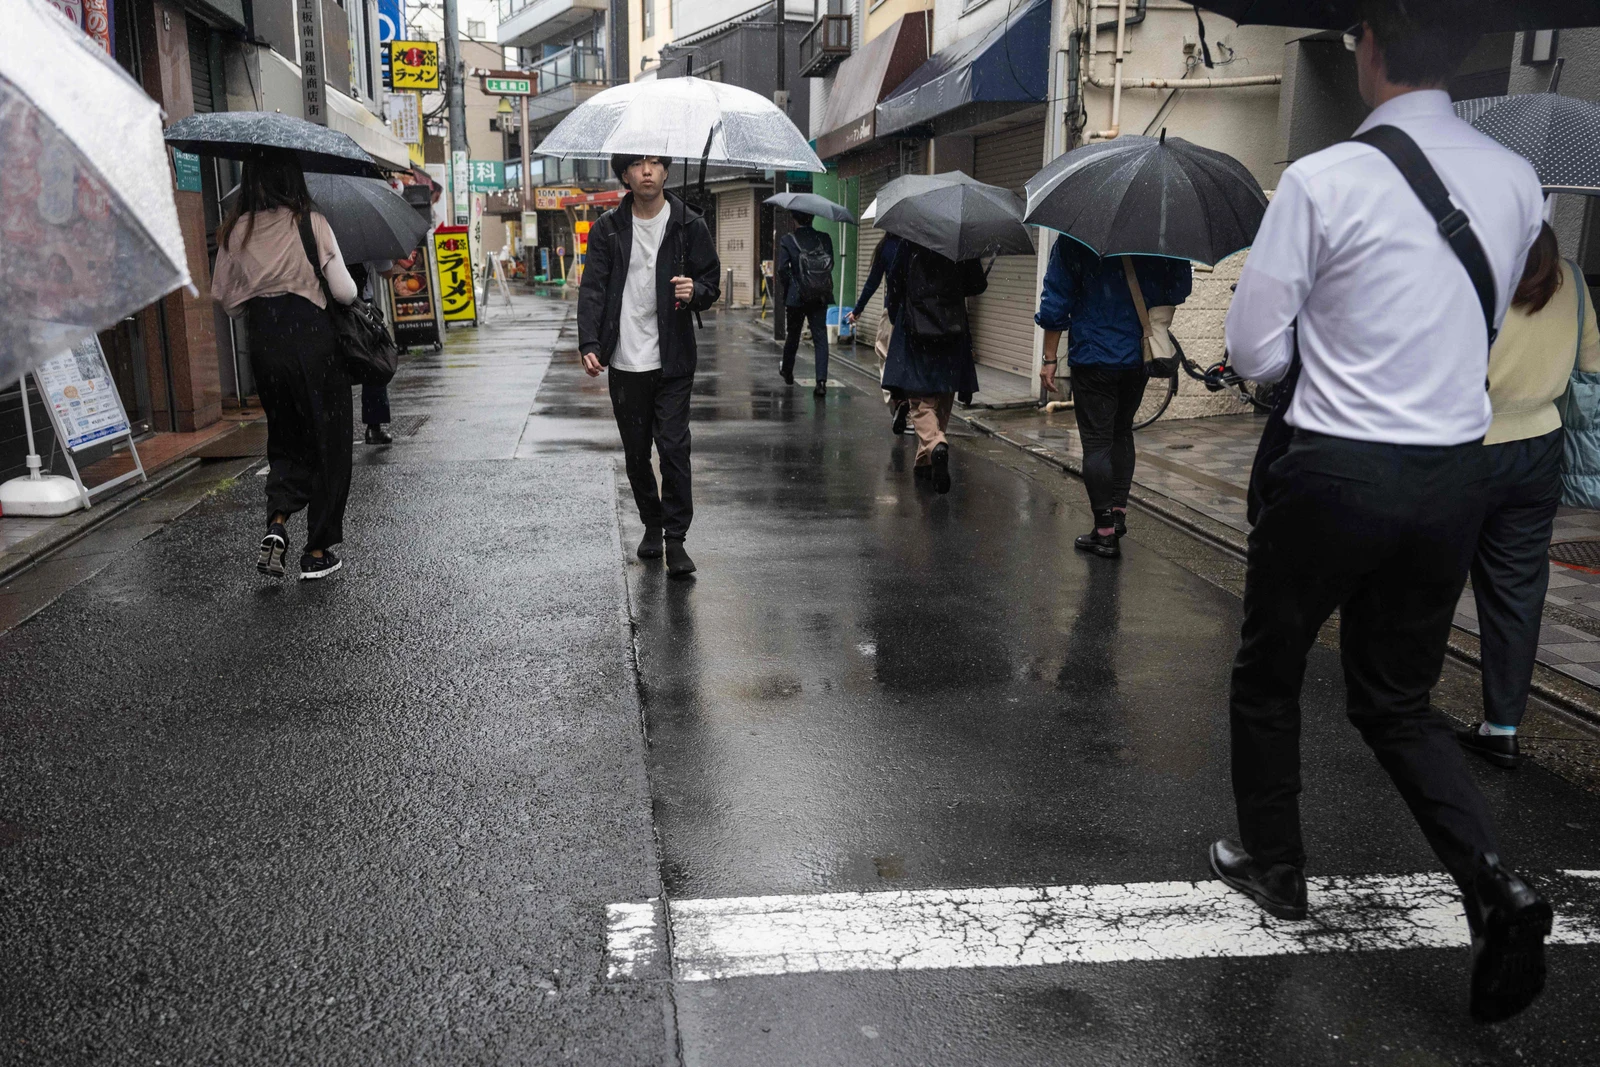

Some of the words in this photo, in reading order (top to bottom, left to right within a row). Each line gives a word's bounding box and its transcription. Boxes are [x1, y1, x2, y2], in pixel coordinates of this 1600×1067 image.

[301, 0, 319, 116] 上板南口銀座商店街
[394, 68, 437, 83] ラーメン
[490, 80, 526, 91] 上板南口
[467, 162, 496, 183] 科
[537, 190, 556, 198] 10M
[437, 252, 471, 315] ラーメン
